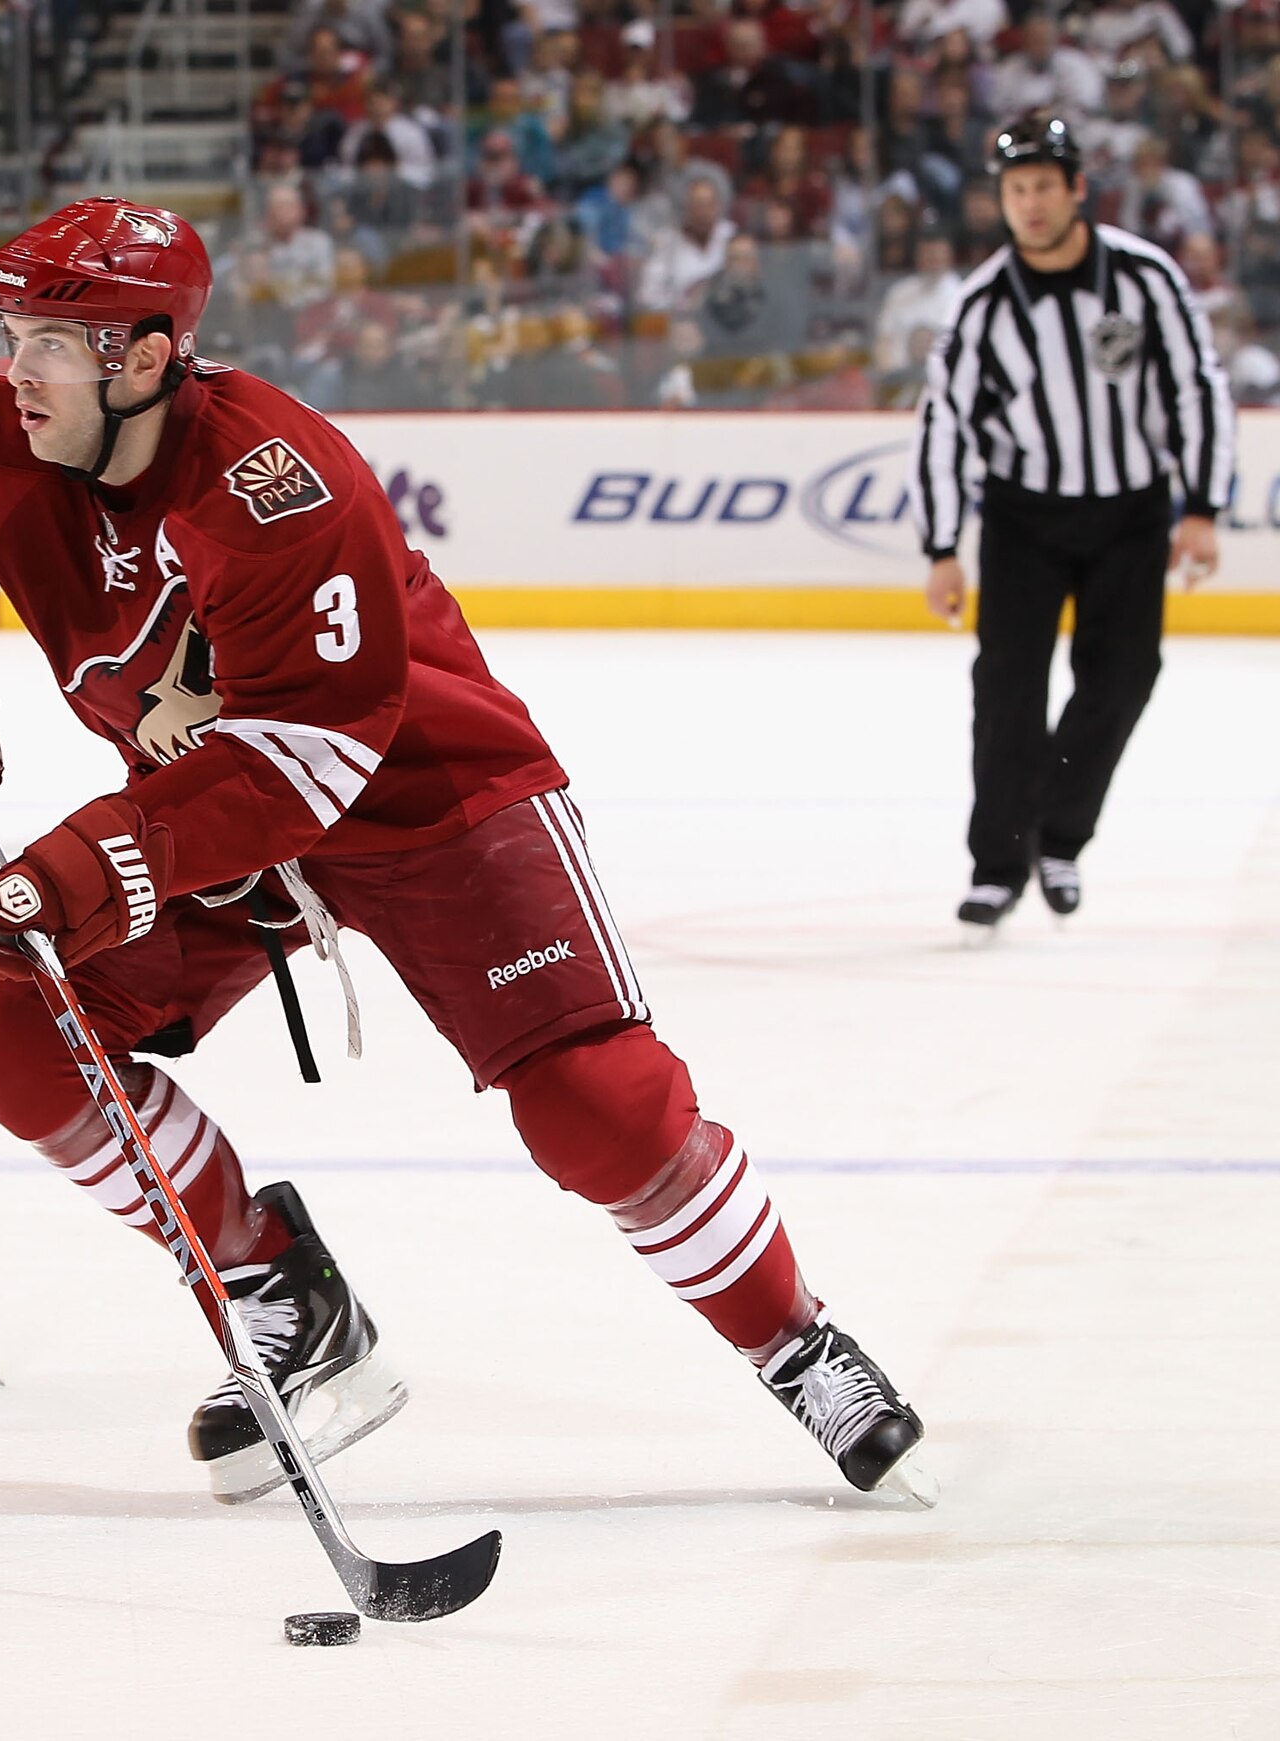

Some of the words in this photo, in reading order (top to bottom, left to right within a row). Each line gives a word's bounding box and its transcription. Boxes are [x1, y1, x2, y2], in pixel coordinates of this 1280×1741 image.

[258, 471, 314, 511] PHX
[572, 473, 790, 522] BUD
[313, 574, 361, 663] 3
[487, 939, 577, 990] Reebok
[55, 1010, 205, 1287] EASTON
